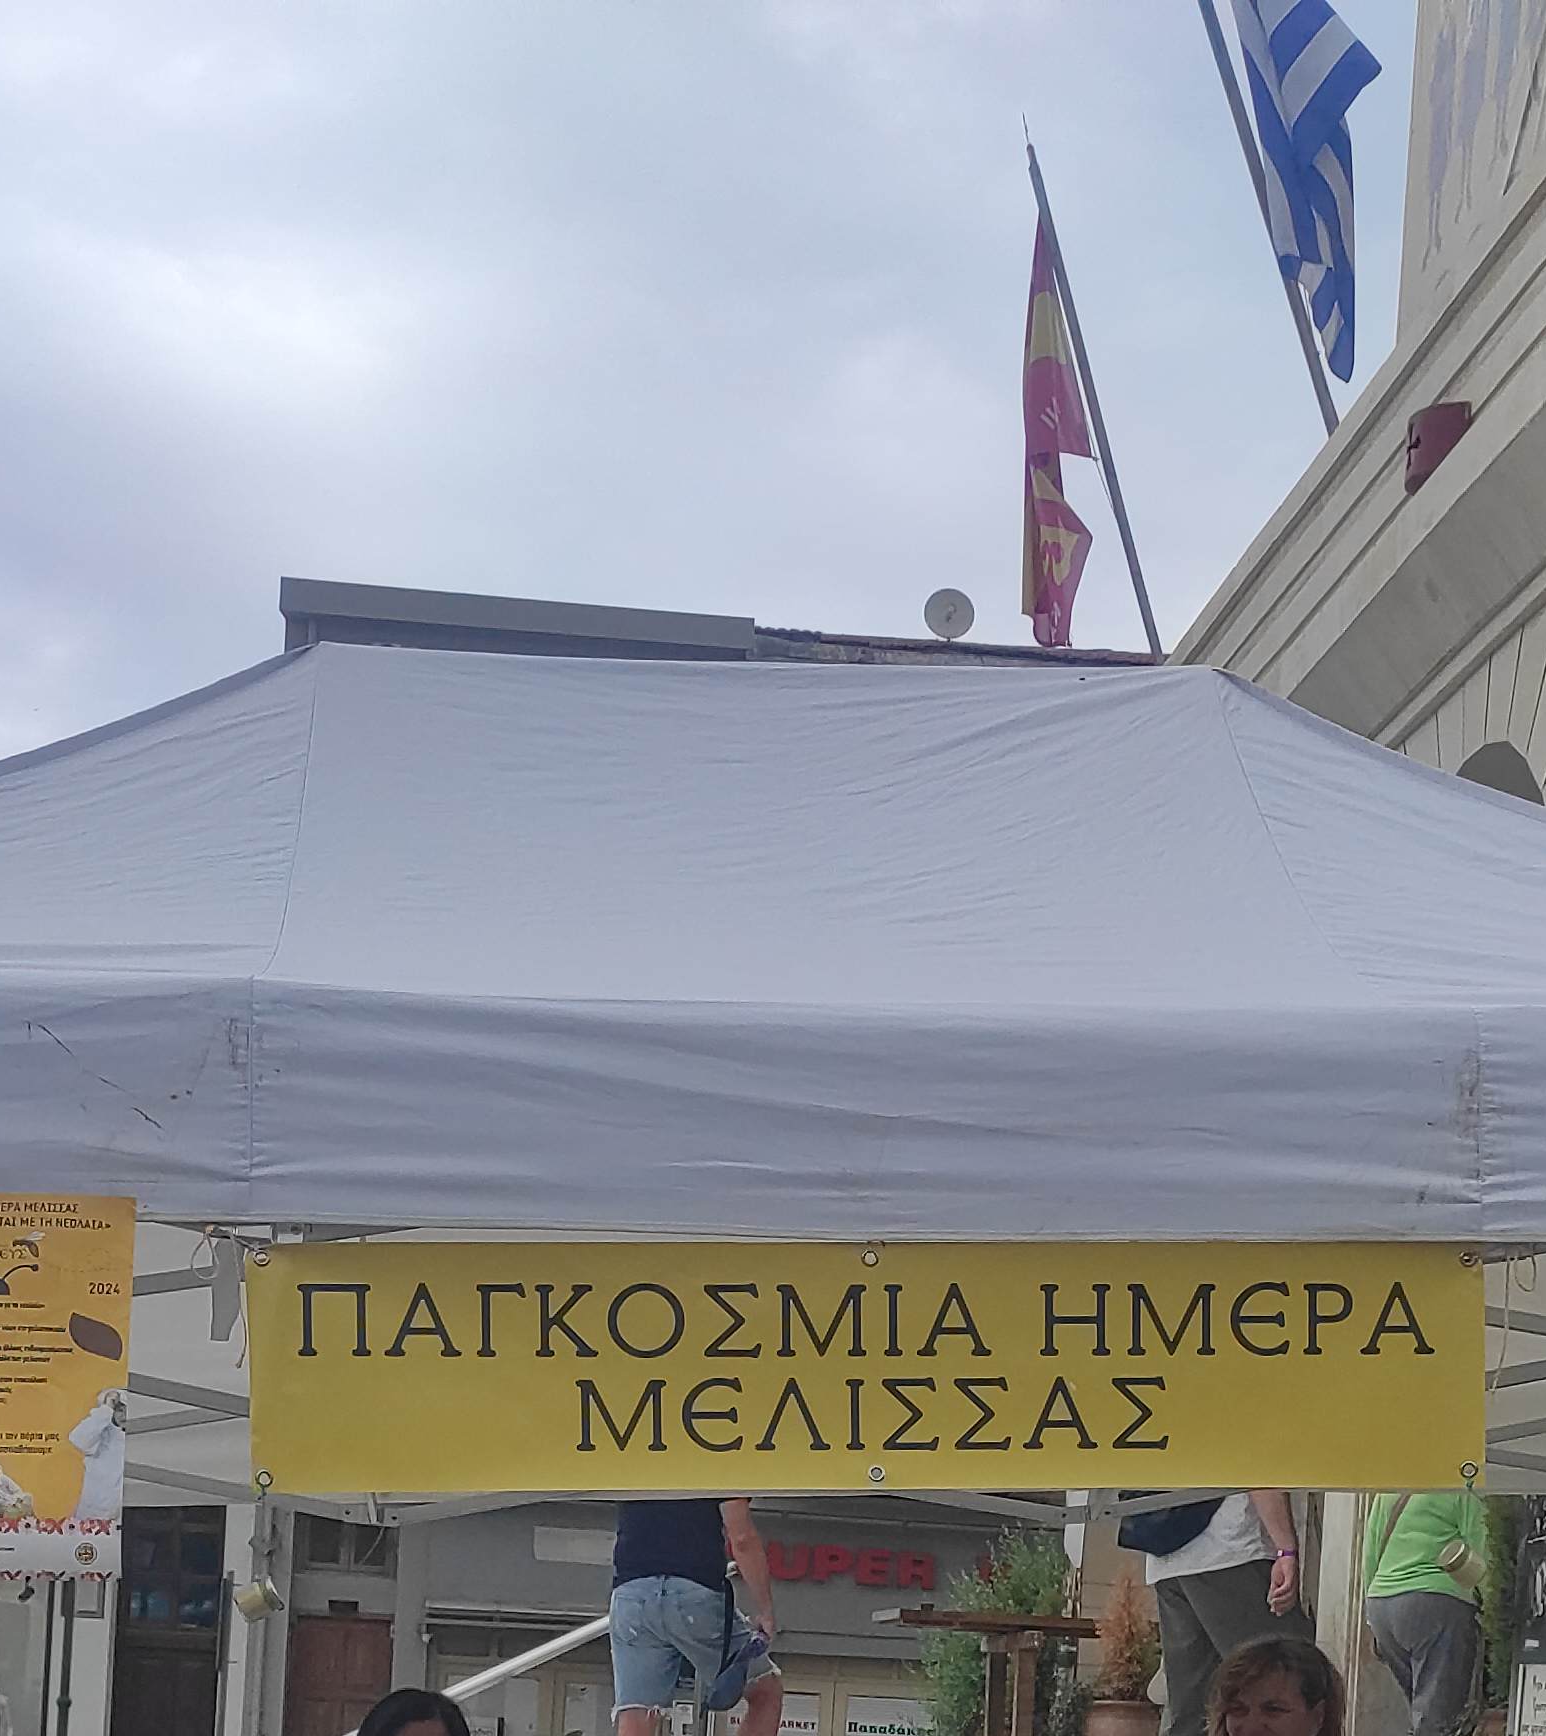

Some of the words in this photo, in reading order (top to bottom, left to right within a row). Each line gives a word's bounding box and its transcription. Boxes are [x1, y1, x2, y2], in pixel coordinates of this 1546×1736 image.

[24, 1202, 80, 1214] ΜΕΛΙΣΣΑΣ
[89, 1282, 121, 1296] 2024
[297, 1281, 993, 1359] ΠΑΓΚΟΣΜΙΑ
[1039, 1279, 1435, 1357] ΗΜΕΡΑ
[575, 1374, 1171, 1454] ΜΕΛΙΣΣΑΣ
[727, 1541, 937, 1591] UPER
[780, 1718, 817, 1731] ARKET
